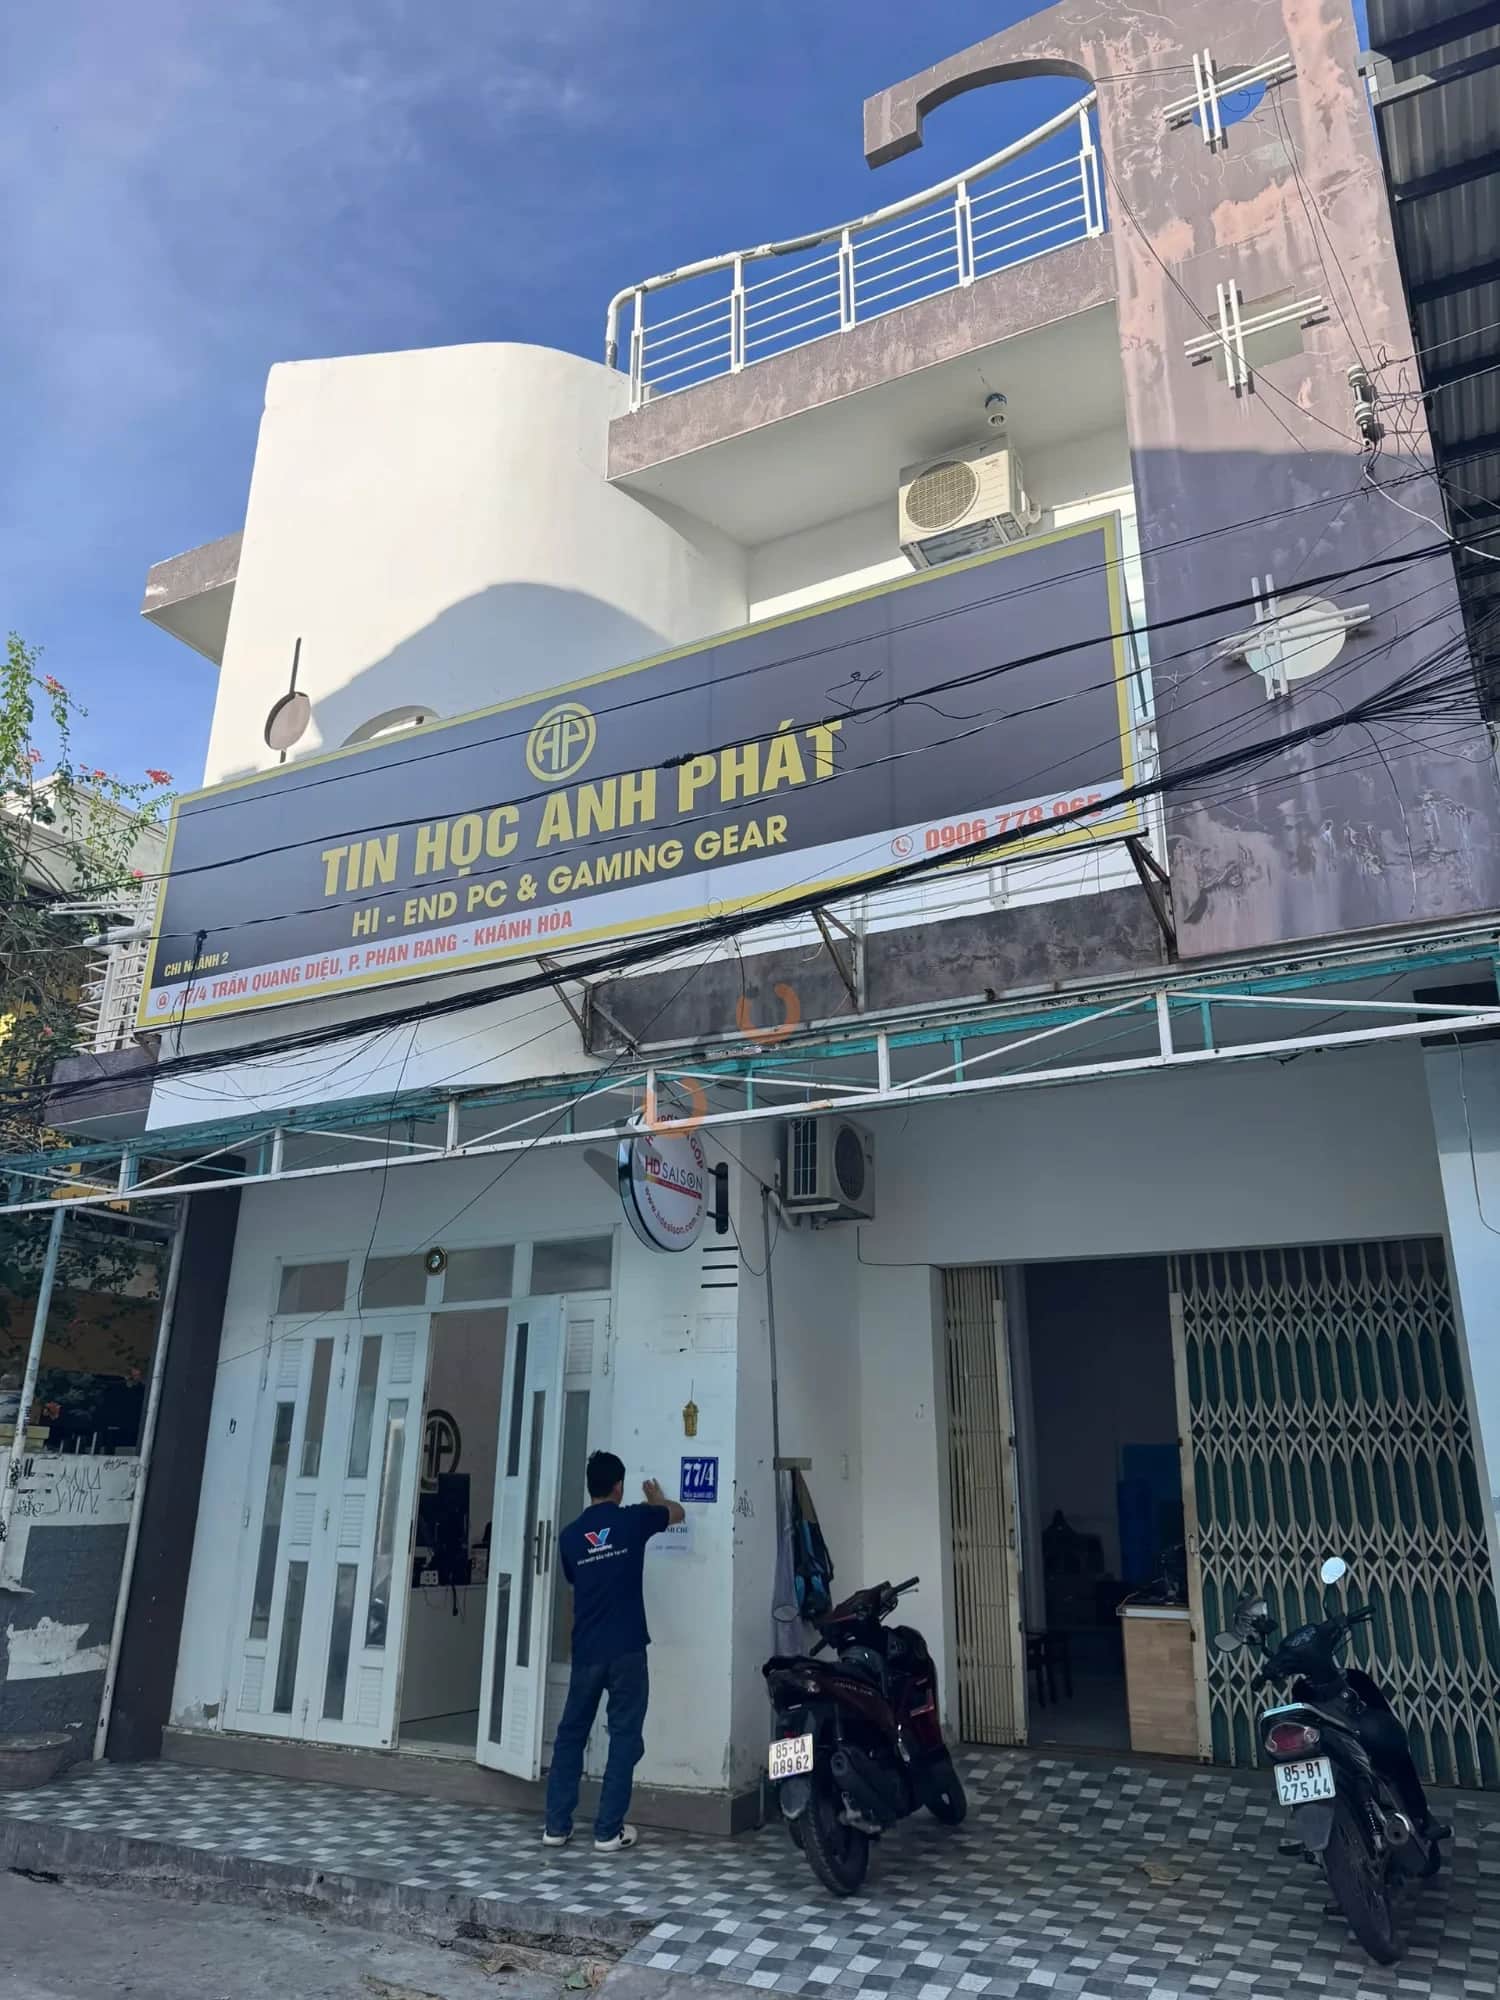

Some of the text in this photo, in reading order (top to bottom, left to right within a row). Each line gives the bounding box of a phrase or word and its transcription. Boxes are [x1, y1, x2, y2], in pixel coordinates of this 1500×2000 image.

[322, 718, 842, 896] TIN HỌC ANH PHÁT
[925, 818, 986, 851] 0906
[352, 907, 380, 936] HI
[403, 890, 457, 926] END
[467, 880, 508, 912] PC
[516, 874, 538, 901] &
[548, 840, 683, 894] GAMING
[694, 814, 788, 861] GEAR
[164, 961, 182, 977] CHI
[220, 951, 230, 965] 2
[212, 973, 248, 999] TRẦN
[252, 966, 301, 992] QUANG
[304, 956, 343, 980] DIỆU,
[348, 955, 360, 971] P.
[365, 944, 408, 968] PHAN
[413, 934, 458, 958] RANG
[474, 920, 532, 946] KHÁNH
[537, 907, 573, 934] HÒA
[644, 1155, 703, 1191] HD SAISON
[683, 1462, 715, 1487] 77/4
[775, 1738, 806, 1760] 85-CA
[772, 1754, 809, 1777] 089.62
[1283, 1761, 1322, 1783] 85-B1
[1281, 1777, 1331, 1802] 275.44
